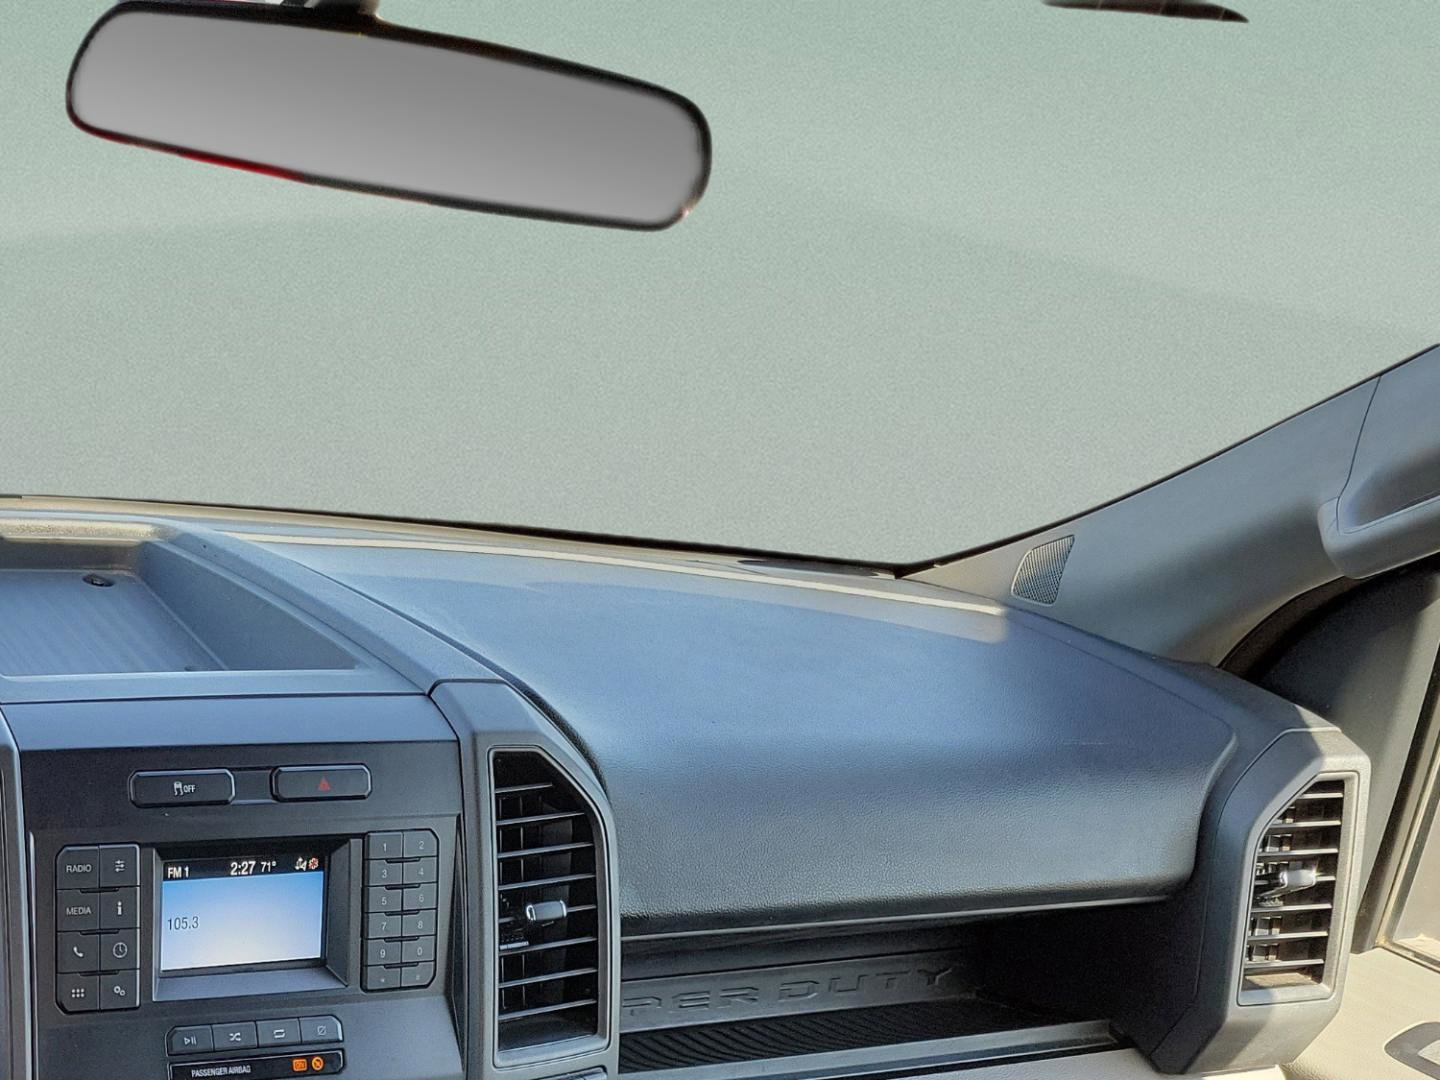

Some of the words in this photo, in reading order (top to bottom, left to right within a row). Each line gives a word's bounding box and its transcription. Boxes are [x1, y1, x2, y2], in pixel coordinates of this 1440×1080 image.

[183, 784, 196, 793] OFF
[418, 840, 424, 850] 2
[66, 864, 92, 873] RADIO
[167, 866, 182, 879] FM
[184, 866, 190, 878] 1
[230, 860, 256, 876] 2:27
[418, 867, 424, 876] 4
[382, 869, 388, 879] 3
[381, 896, 387, 906] 5
[66, 906, 92, 916] MEDIA
[168, 916, 199, 930] 105.3
[381, 922, 387, 931] 7
[380, 949, 386, 958] 9
[416, 946, 423, 956] 0
[622, 985, 760, 1018] PER
[777, 967, 953, 1003] DUTY
[191, 1066, 228, 1078] PASSENGER
